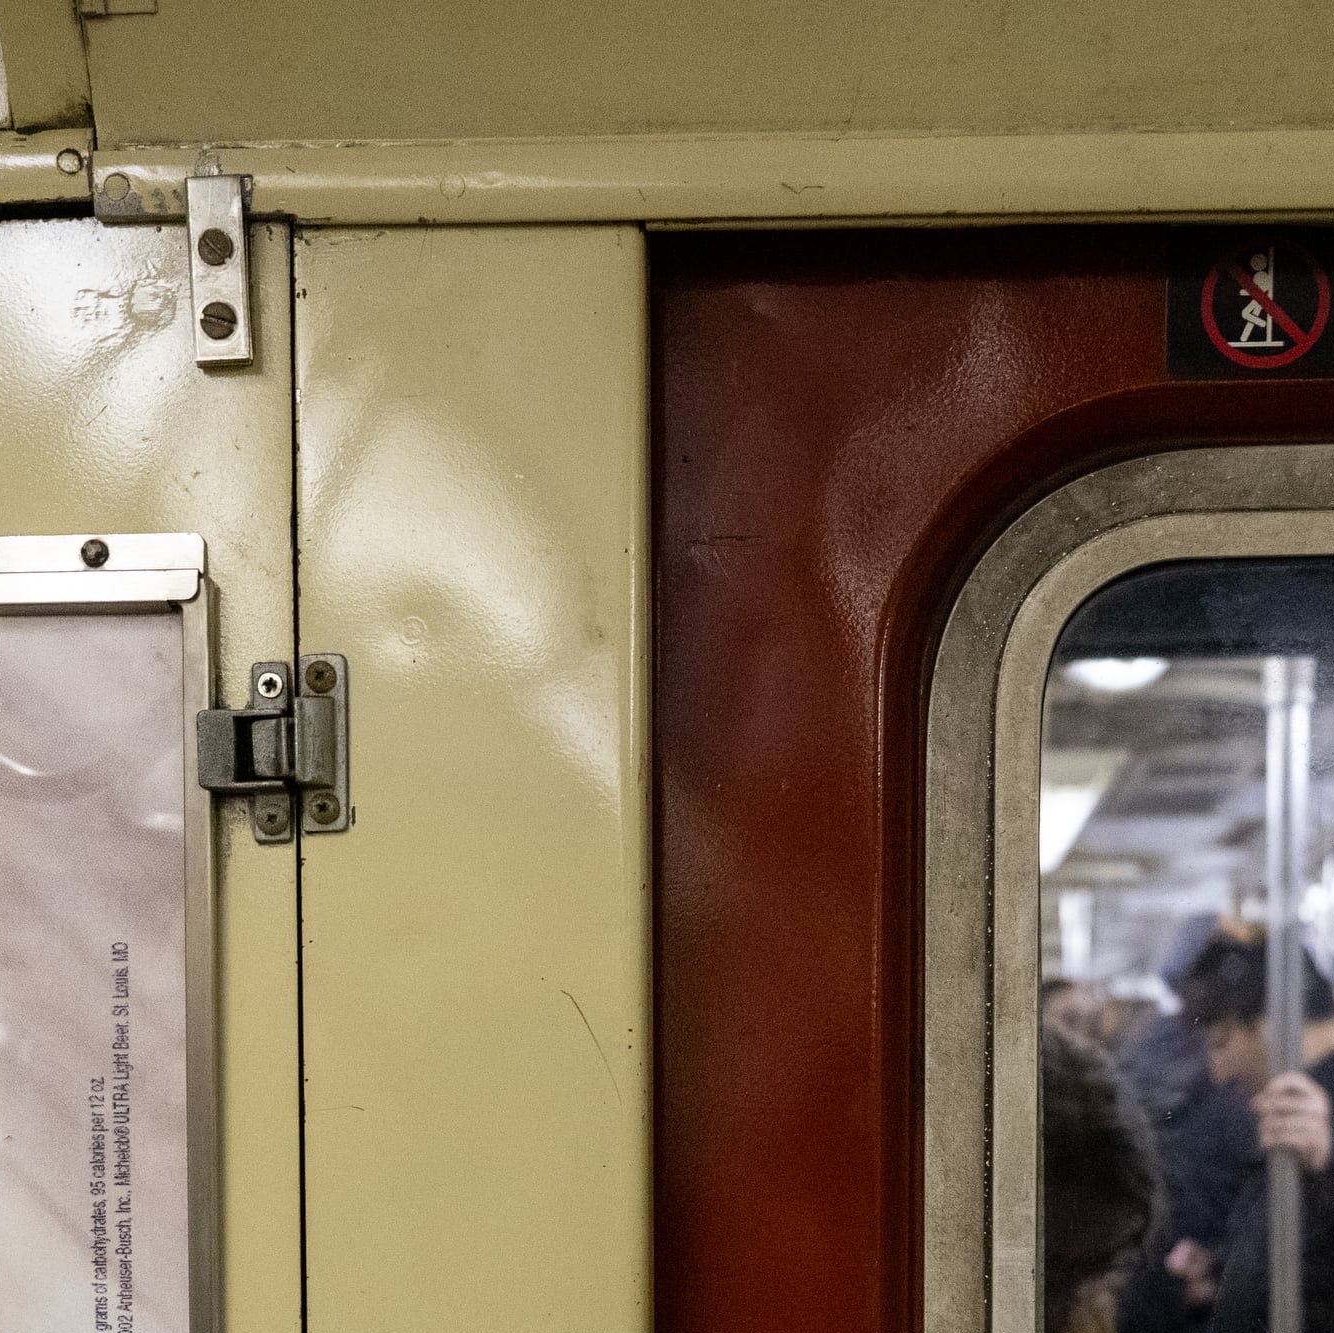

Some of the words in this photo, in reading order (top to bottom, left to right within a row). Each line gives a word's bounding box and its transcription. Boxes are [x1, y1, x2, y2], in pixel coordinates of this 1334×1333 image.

[112, 942, 129, 962] MO
[112, 1054, 134, 1080] Light
[88, 1095, 105, 1108] 12
[113, 1083, 130, 1124] ULTRA
[90, 1112, 109, 1132] per
[89, 1133, 106, 1178] calories
[90, 1180, 106, 1196] 95
[90, 1199, 111, 1281] carbohydrates,
[115, 1217, 133, 1312] Anheuser-Busch,
[91, 1283, 107, 1294] of
[94, 1296, 112, 1331] grams
